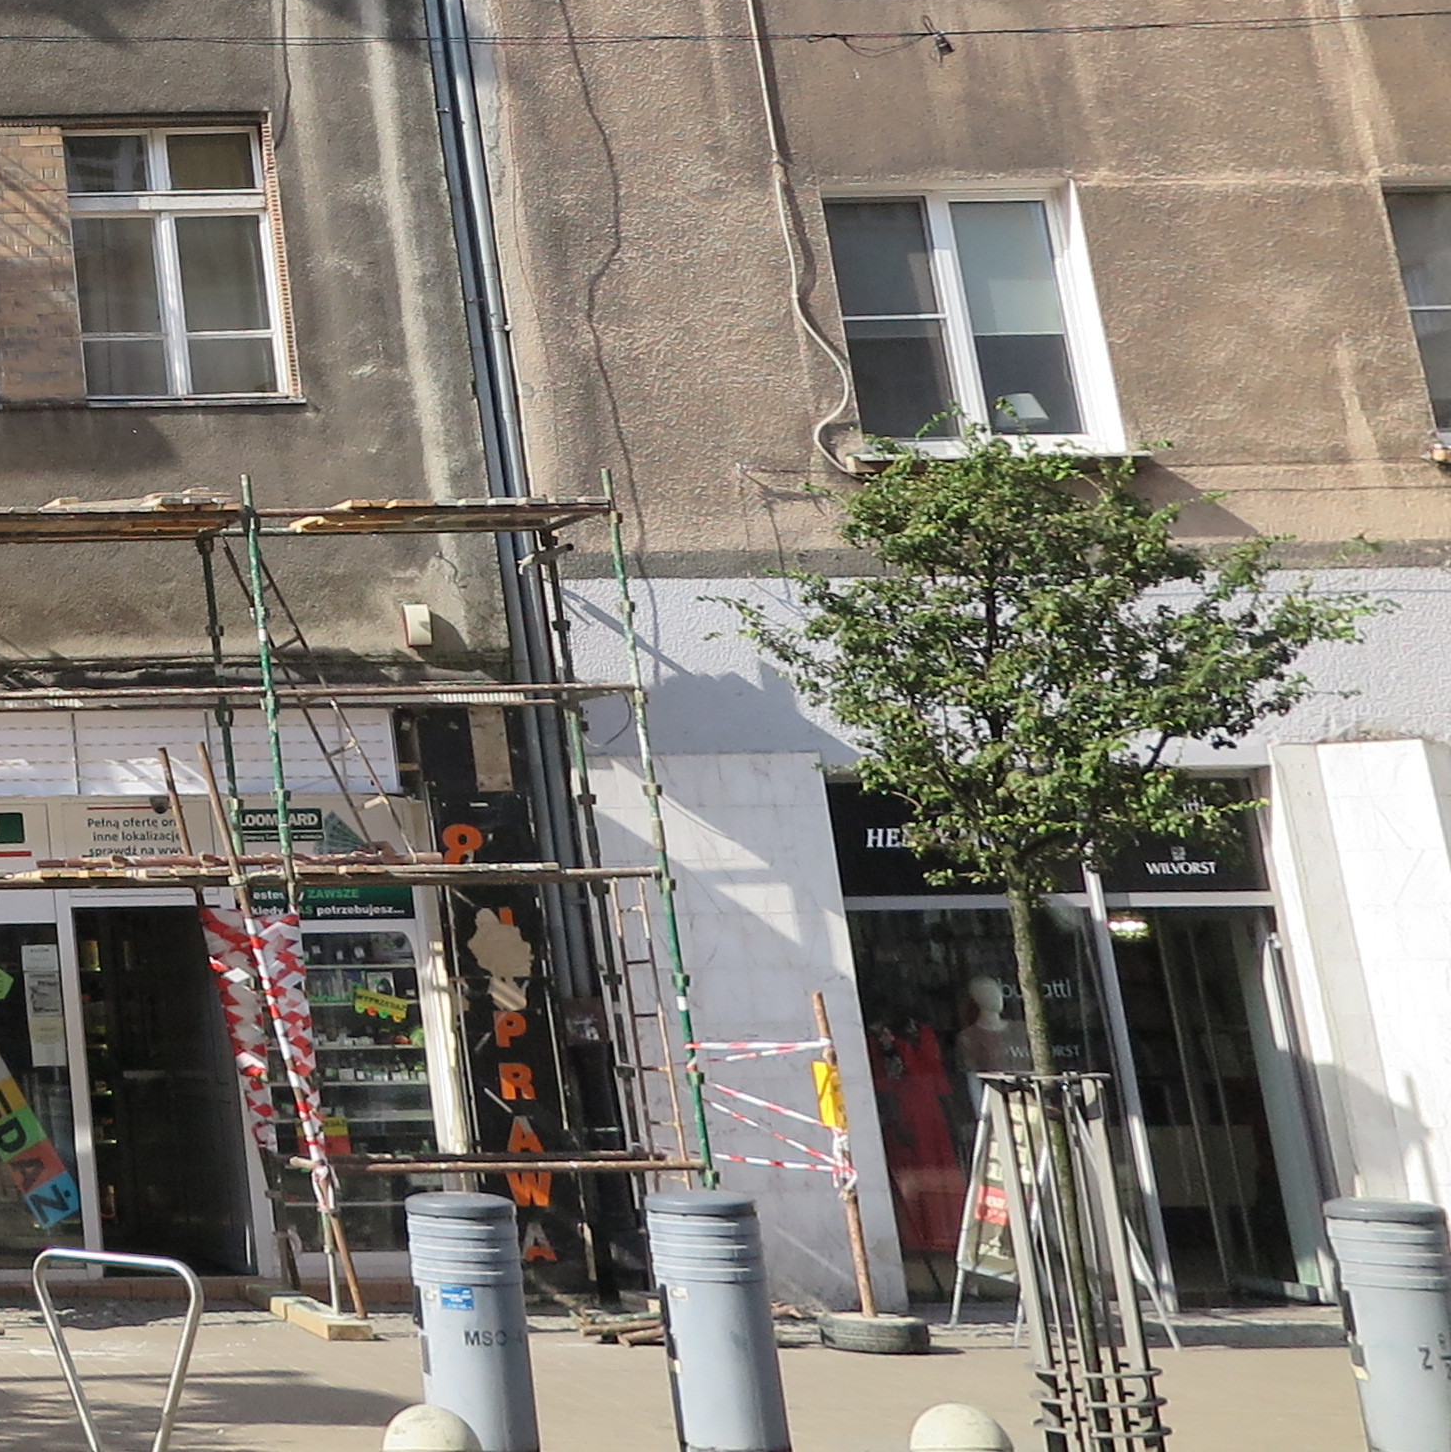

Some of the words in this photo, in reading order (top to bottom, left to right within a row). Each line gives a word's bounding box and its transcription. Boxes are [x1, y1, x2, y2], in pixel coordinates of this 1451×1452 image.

[87, 818, 120, 829] Pełną
[240, 813, 319, 827] LOOMARD
[93, 832, 119, 842] inne
[141, 847, 155, 856] na
[1144, 861, 1217, 875] WILVORST
[307, 888, 359, 899] ZAWSZE
